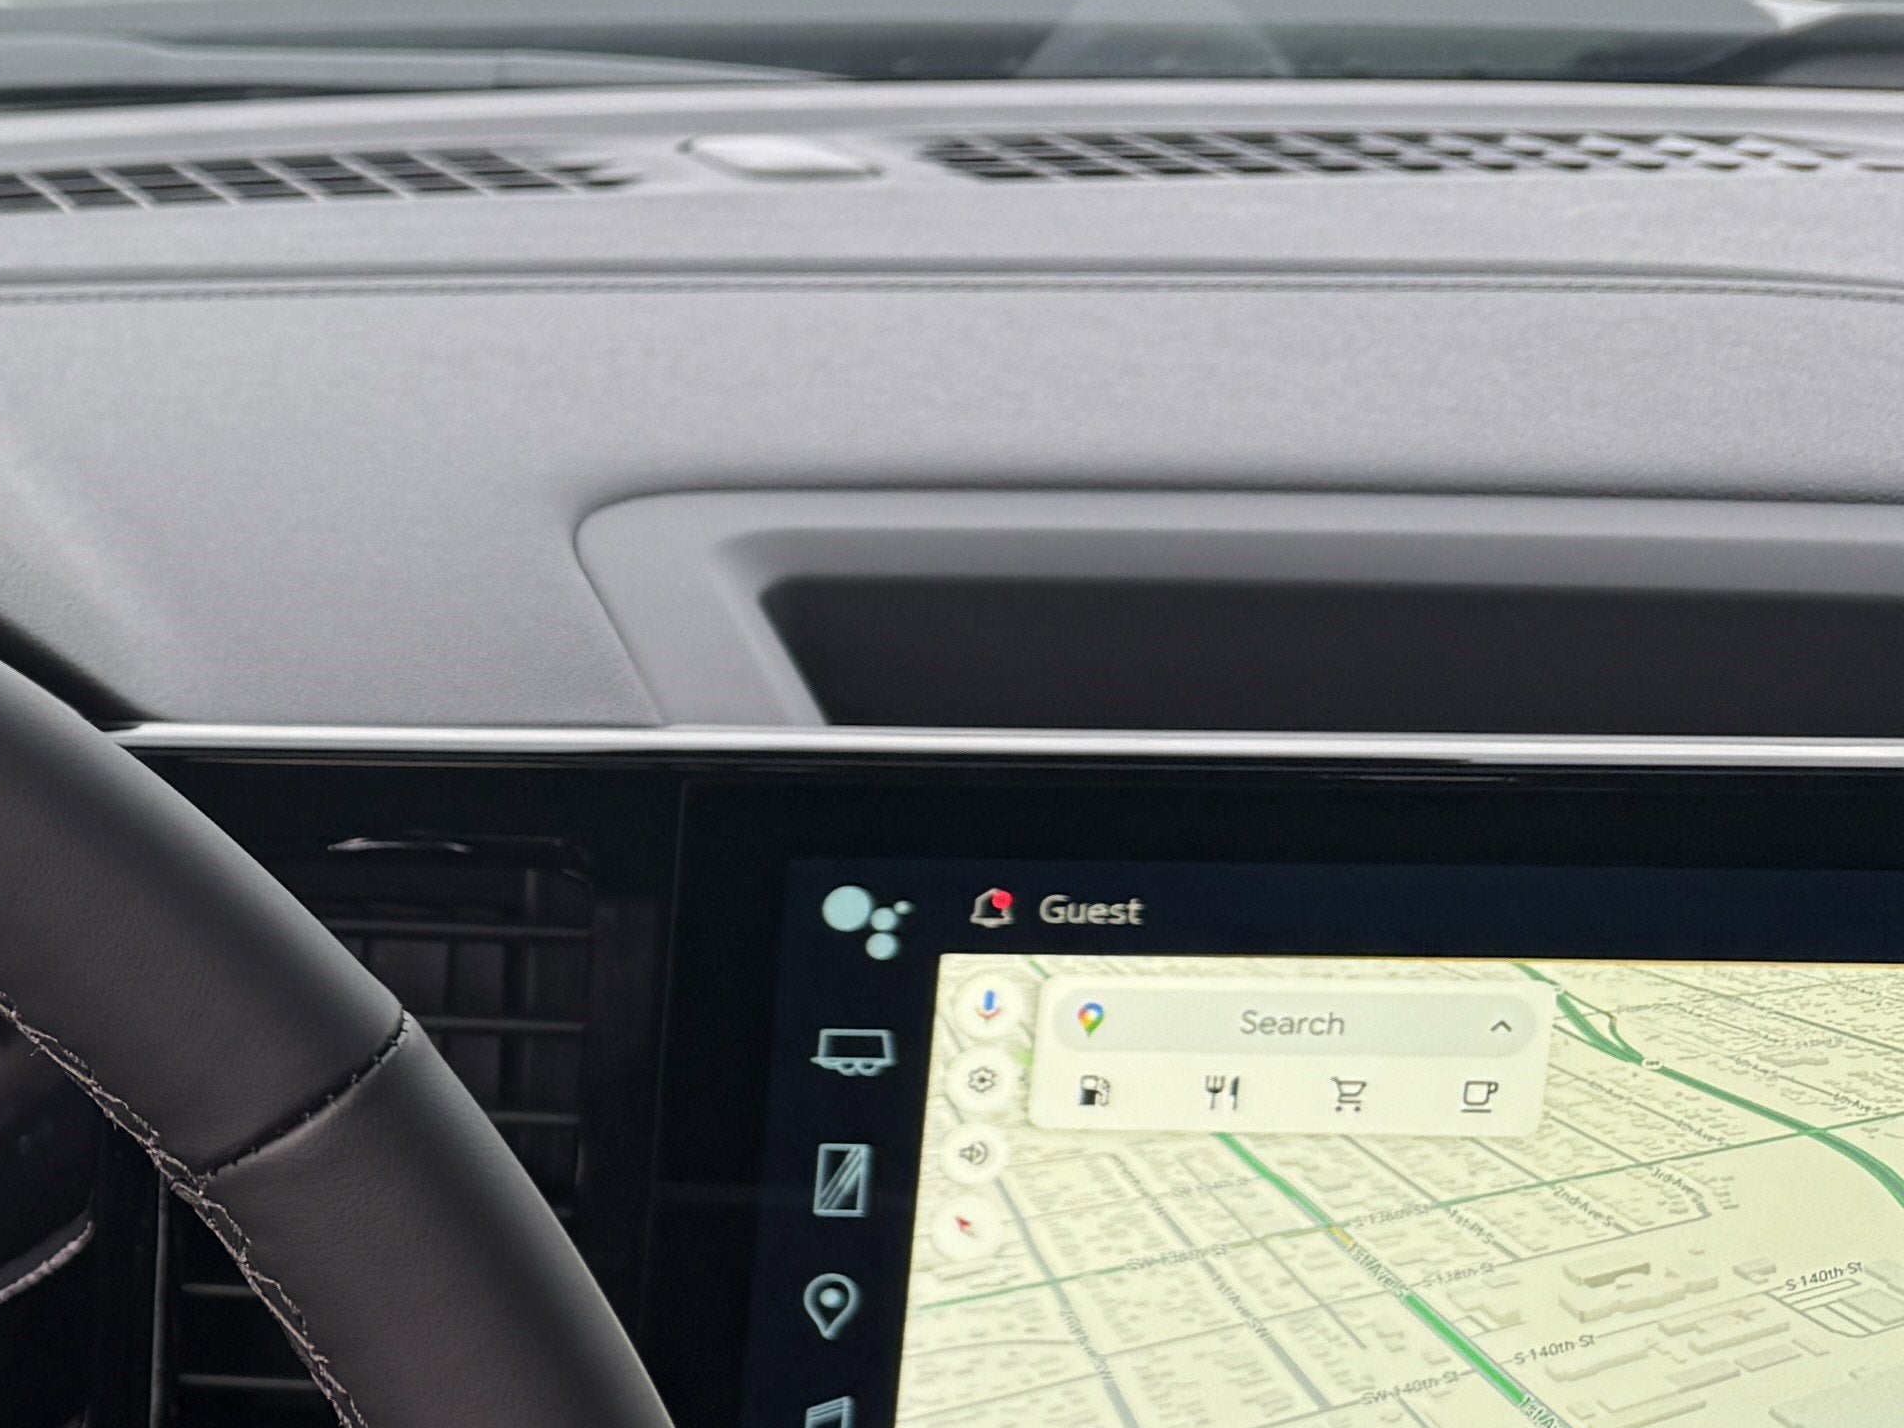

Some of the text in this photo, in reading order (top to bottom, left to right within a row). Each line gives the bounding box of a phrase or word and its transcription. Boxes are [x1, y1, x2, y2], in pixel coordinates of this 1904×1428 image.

[1039, 894, 1144, 925] Guest
[1239, 1009, 1346, 1037] Search
[1553, 1186, 1581, 1204] 2nd
[1579, 1201, 1603, 1219] Ave
[1786, 1261, 1863, 1291] S 140th St
[1513, 1334, 1596, 1365] S 140th St
